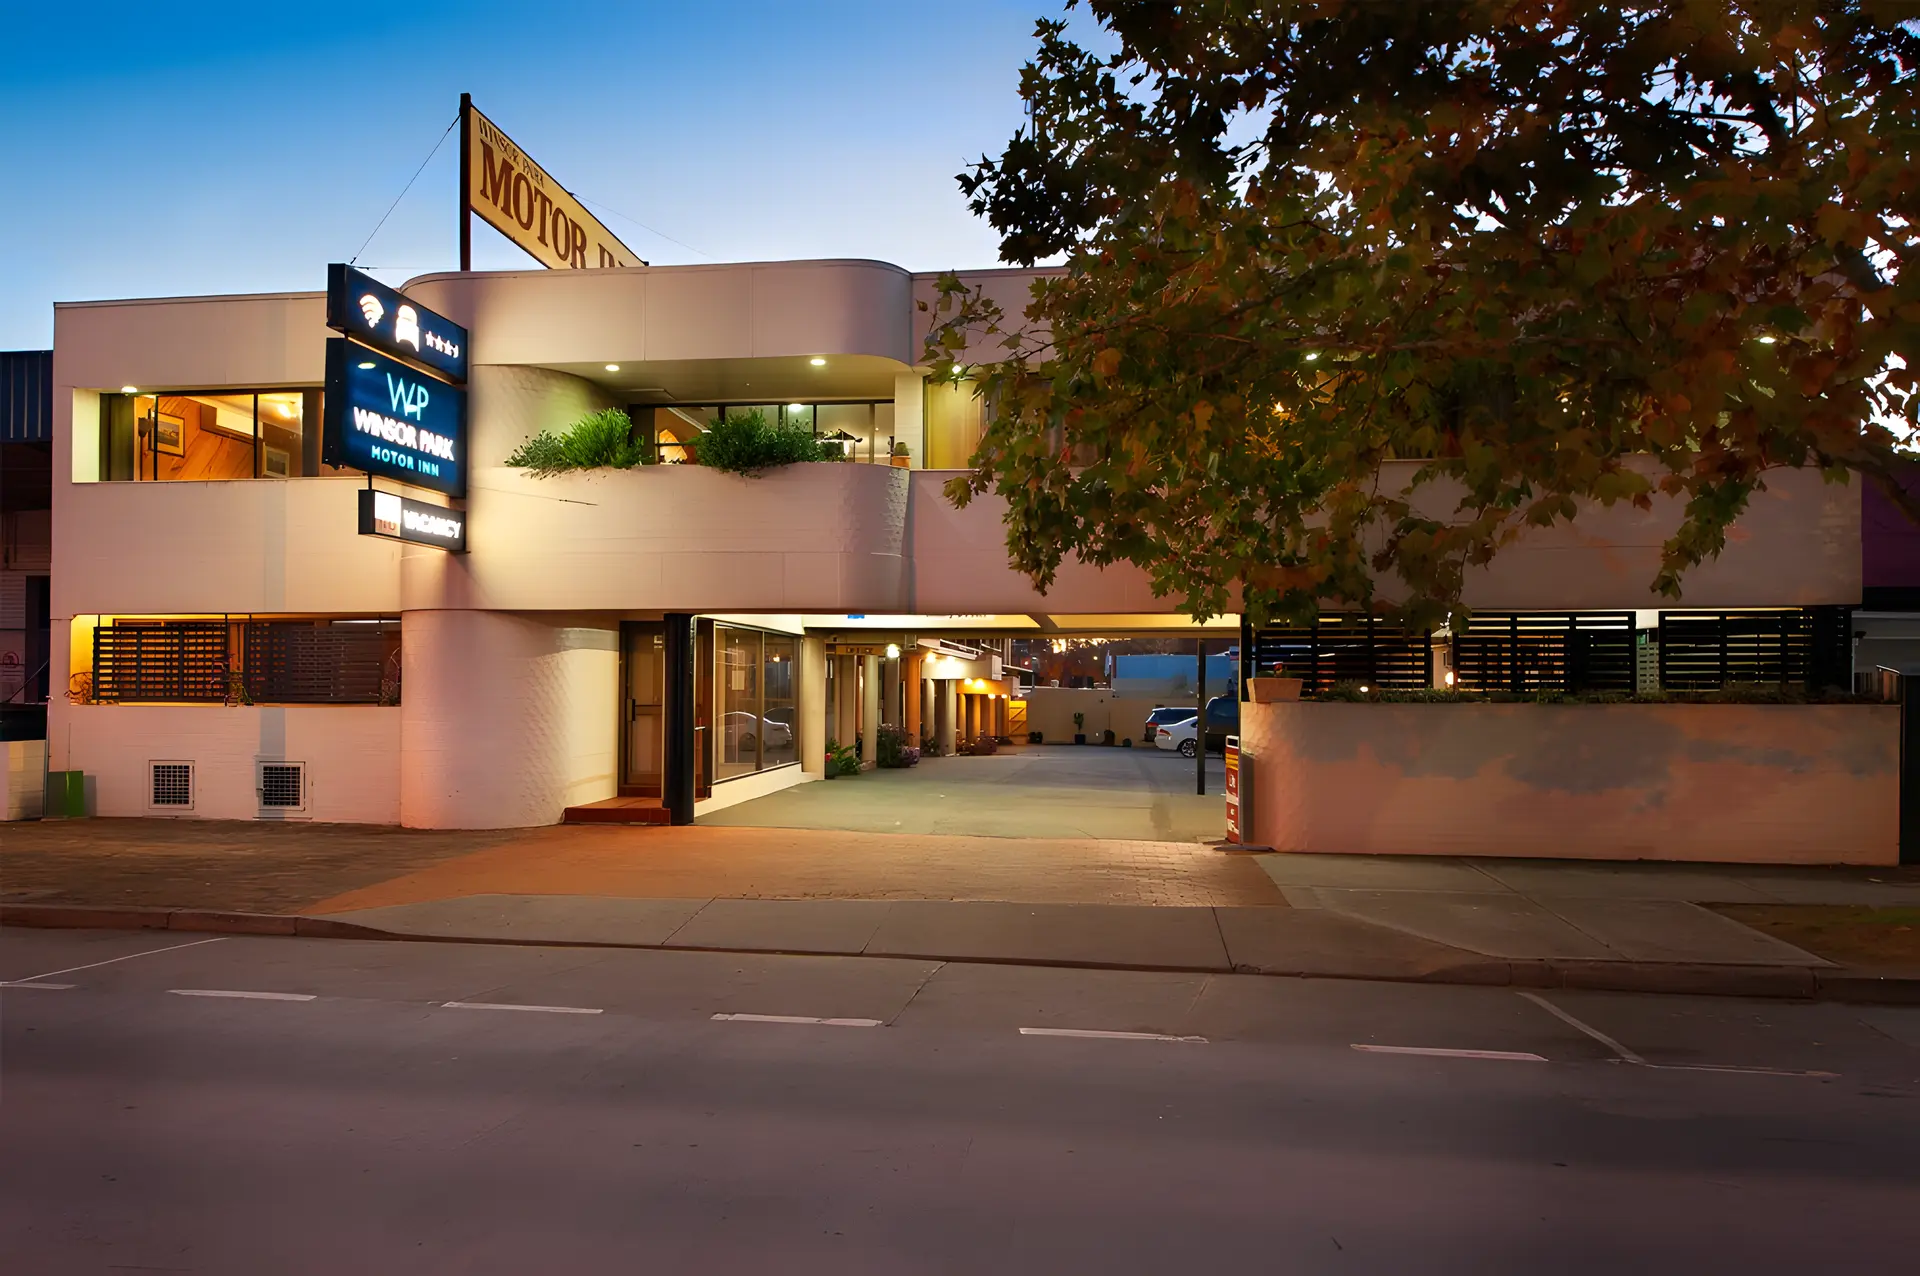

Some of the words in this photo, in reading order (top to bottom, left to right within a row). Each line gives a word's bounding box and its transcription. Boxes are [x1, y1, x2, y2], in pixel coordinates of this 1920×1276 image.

[480, 138, 587, 270] MOTOR
[353, 406, 417, 451] WINSOR
[420, 429, 455, 461] PARK
[371, 445, 414, 470] MOTOR
[418, 459, 440, 477] INN
